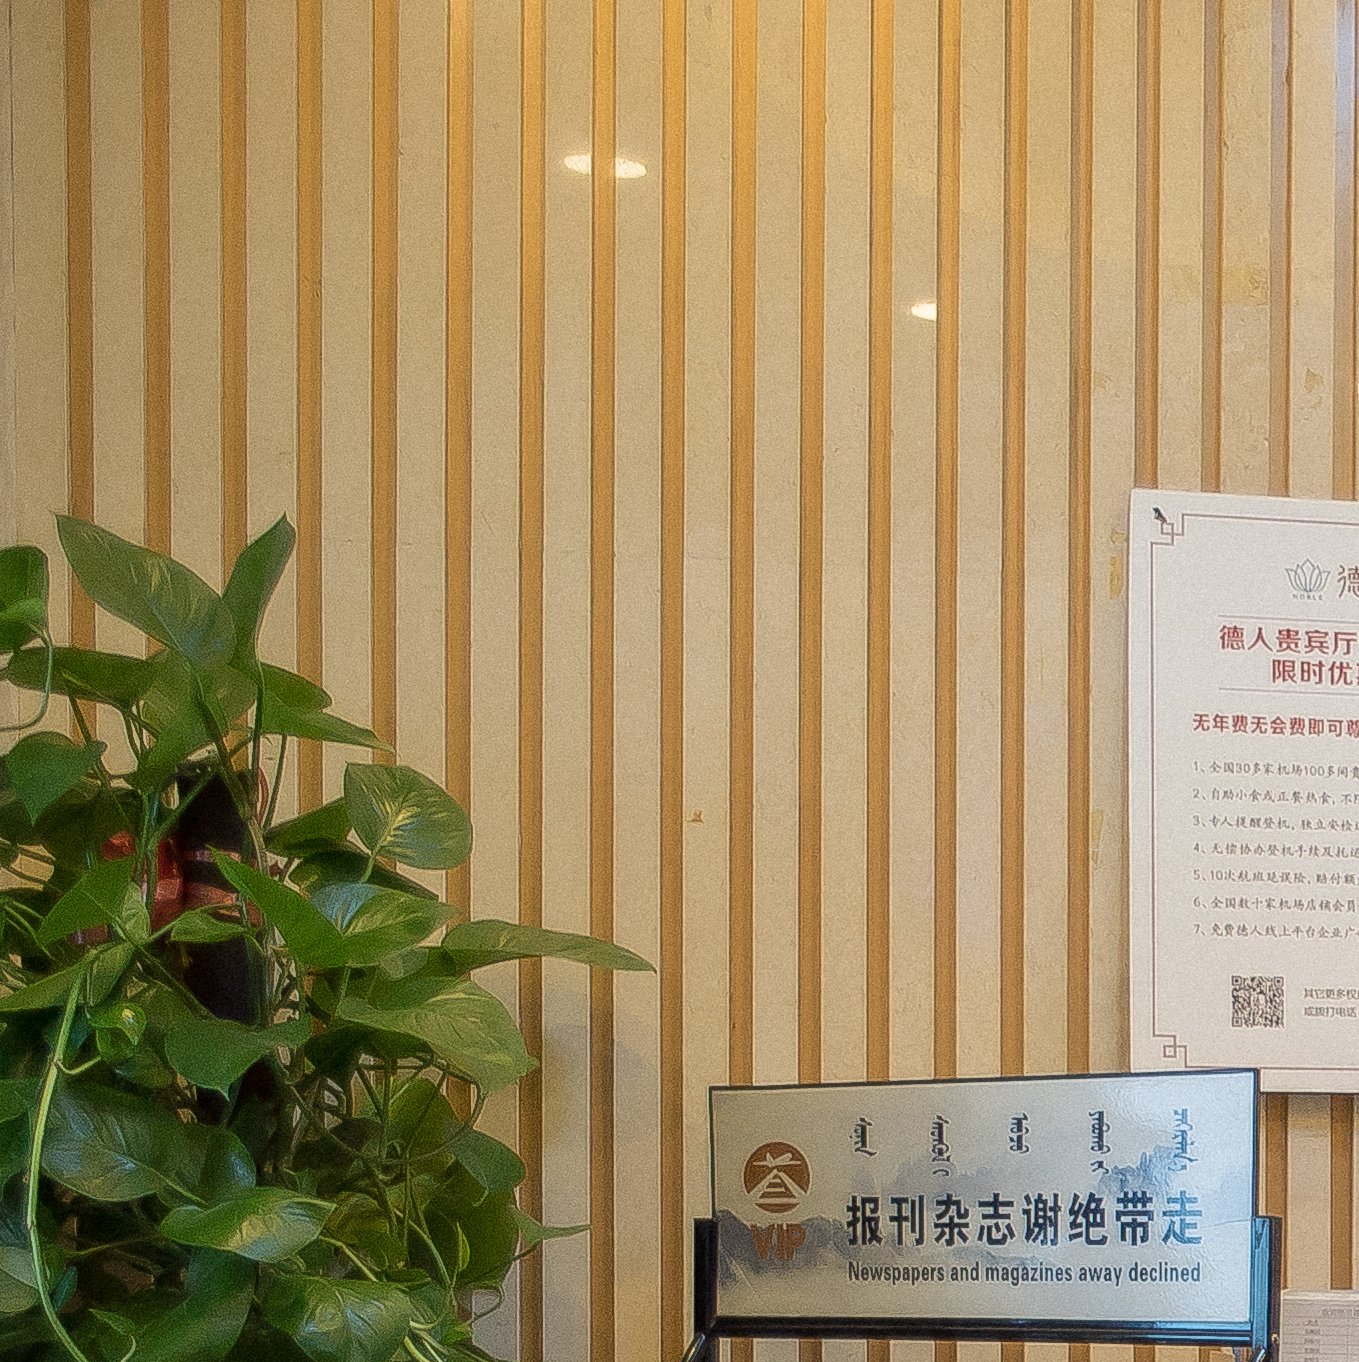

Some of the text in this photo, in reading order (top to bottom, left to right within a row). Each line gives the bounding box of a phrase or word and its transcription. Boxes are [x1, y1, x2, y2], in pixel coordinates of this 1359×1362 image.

[846, 1191, 1203, 1248] 报刊杂志谢绝带走
[750, 1222, 807, 1261] VIP
[848, 1260, 1201, 1287] Newspapers and magazines away declined
